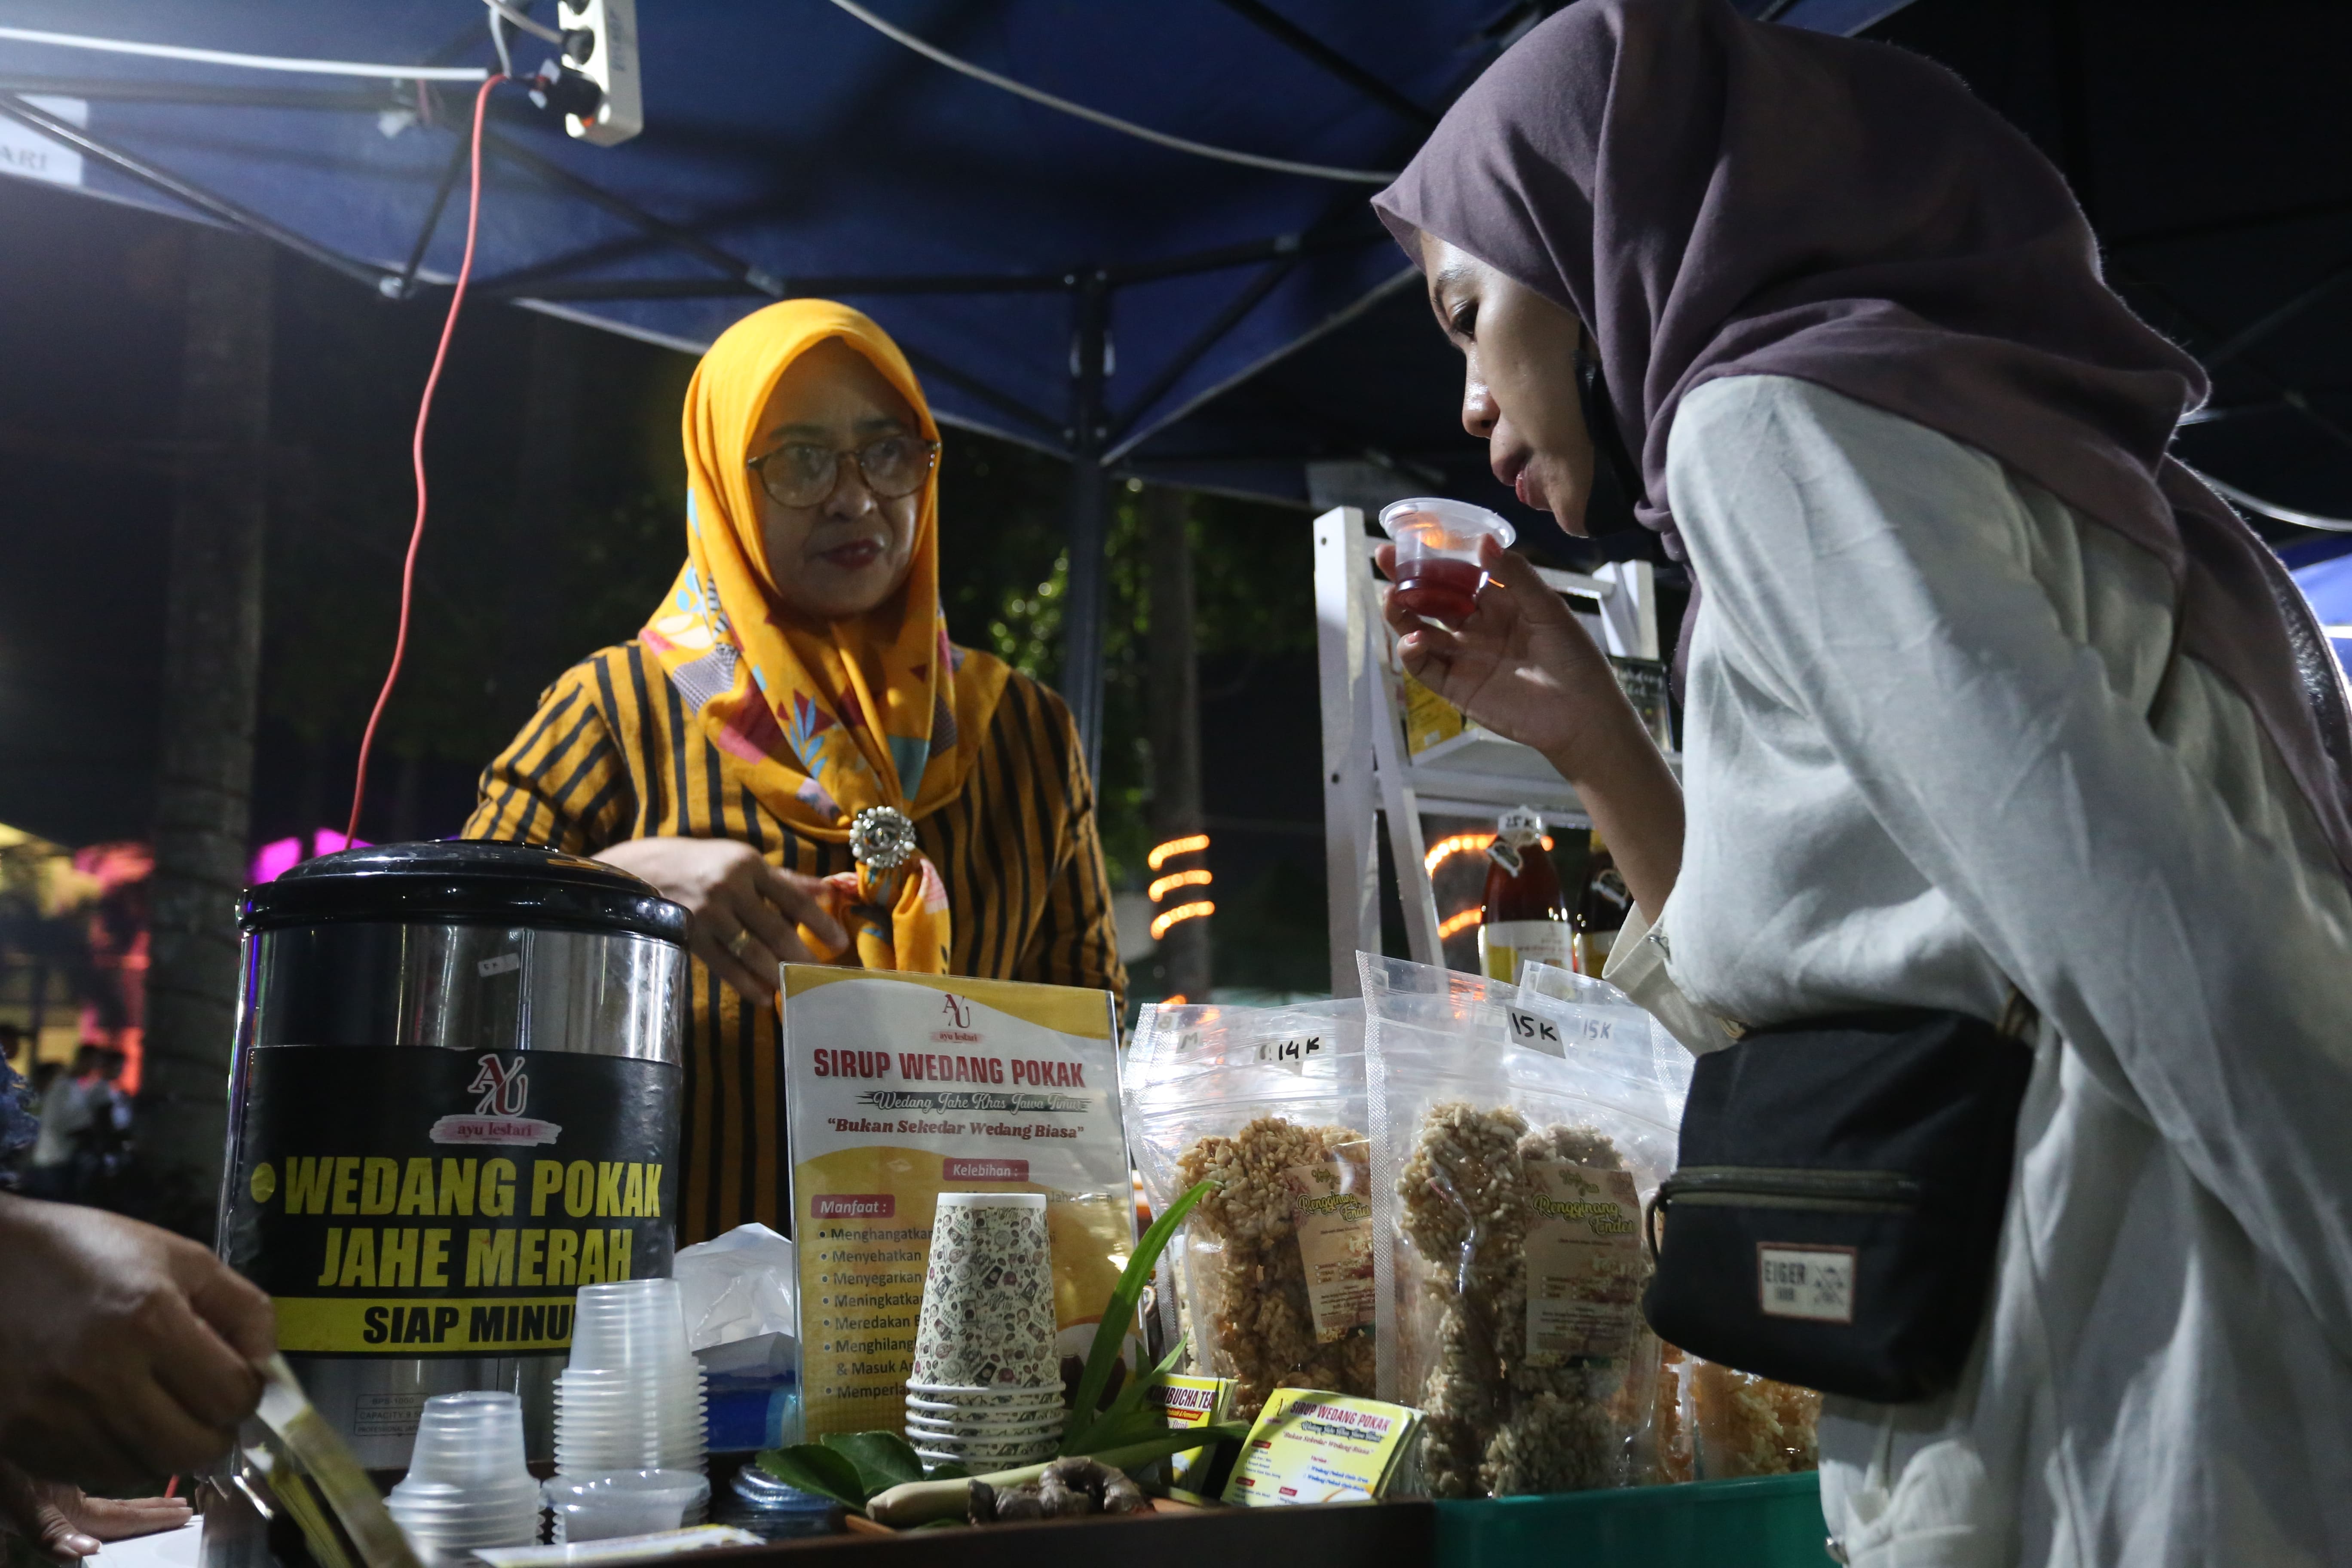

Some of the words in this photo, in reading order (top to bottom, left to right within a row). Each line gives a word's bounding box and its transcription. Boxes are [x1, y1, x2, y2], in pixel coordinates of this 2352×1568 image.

[813, 1048, 891, 1078] SIRUP
[898, 1052, 1004, 1084] WEDANG
[1011, 1059, 1087, 1088] POKAK
[873, 1091, 932, 1113] Wedang
[937, 1091, 968, 1114] Jahe
[972, 1093, 1007, 1110] Khas
[1011, 1093, 1044, 1115] Jawa
[458, 1124, 483, 1137] ayu
[489, 1121, 532, 1136] lestari
[897, 1120, 966, 1135] Sekedar
[970, 1121, 1032, 1140] Wedang
[953, 1163, 1011, 1178] Kelebihan
[285, 1156, 516, 1217] WEDANG
[530, 1160, 662, 1218] POKAK
[820, 1199, 879, 1214] Manfaat
[317, 1228, 451, 1287] JAHE
[465, 1228, 633, 1287] MERAH
[832, 1249, 922, 1265] Menyehatkan
[833, 1270, 922, 1287] Menyegarkan
[363, 1306, 459, 1344] SIAP
[468, 1305, 576, 1343] MINU
[835, 1315, 910, 1330] Meredakan
[836, 1335, 917, 1354] Menghilang
[836, 1363, 847, 1375] &
[851, 1360, 896, 1375] Masuk
[837, 1382, 910, 1400] Memperla
[1289, 1401, 1317, 1416] SIRUP
[1317, 1405, 1357, 1424] WEDANG
[1357, 1414, 1391, 1432] POKAK
